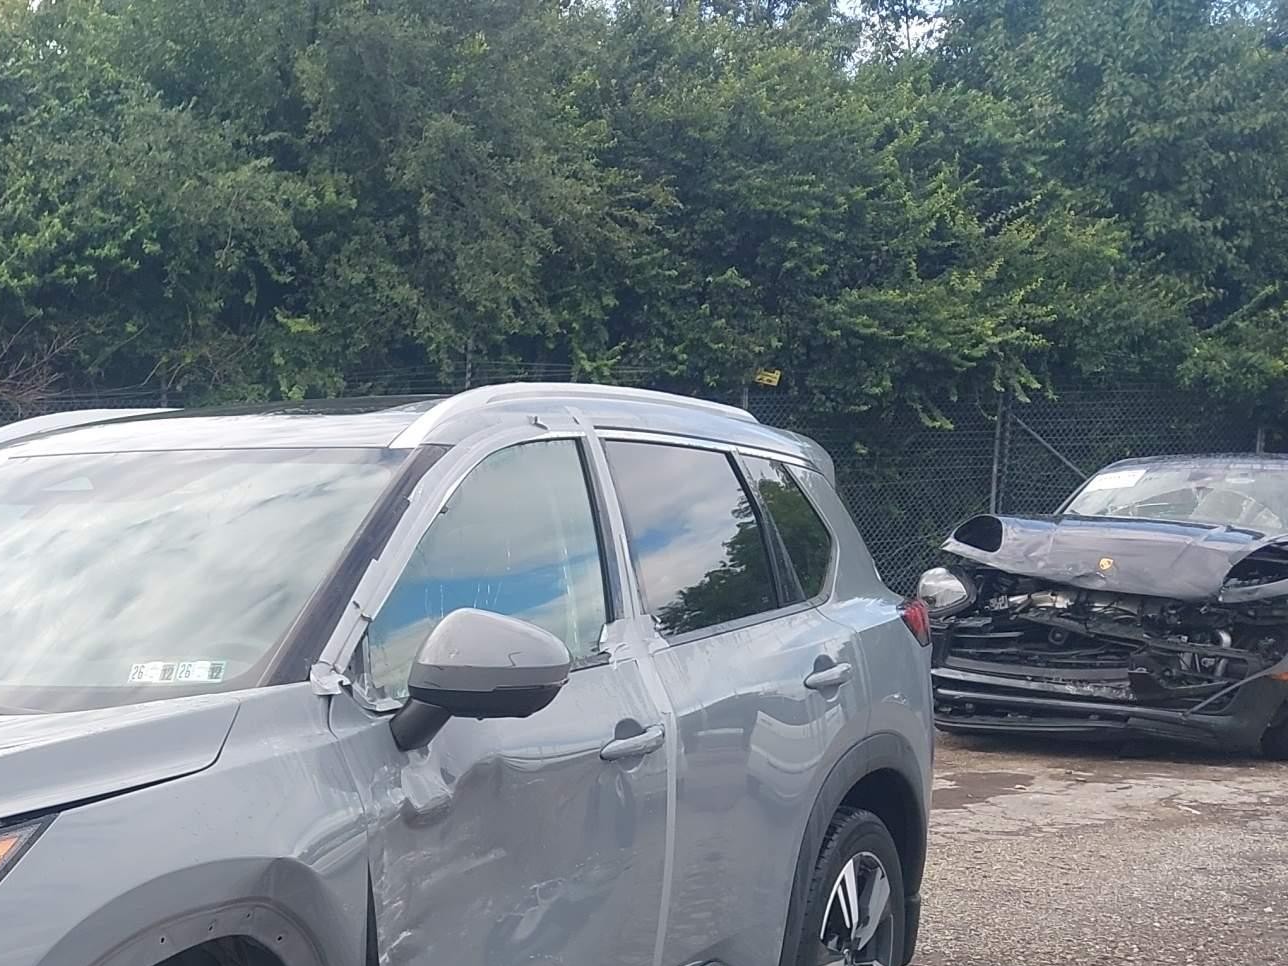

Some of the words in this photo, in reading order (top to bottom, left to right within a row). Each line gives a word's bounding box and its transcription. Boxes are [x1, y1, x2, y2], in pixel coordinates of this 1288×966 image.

[131, 664, 145, 680] 26
[160, 667, 175, 681] 12
[178, 663, 192, 679] 26
[209, 666, 223, 680] 12
